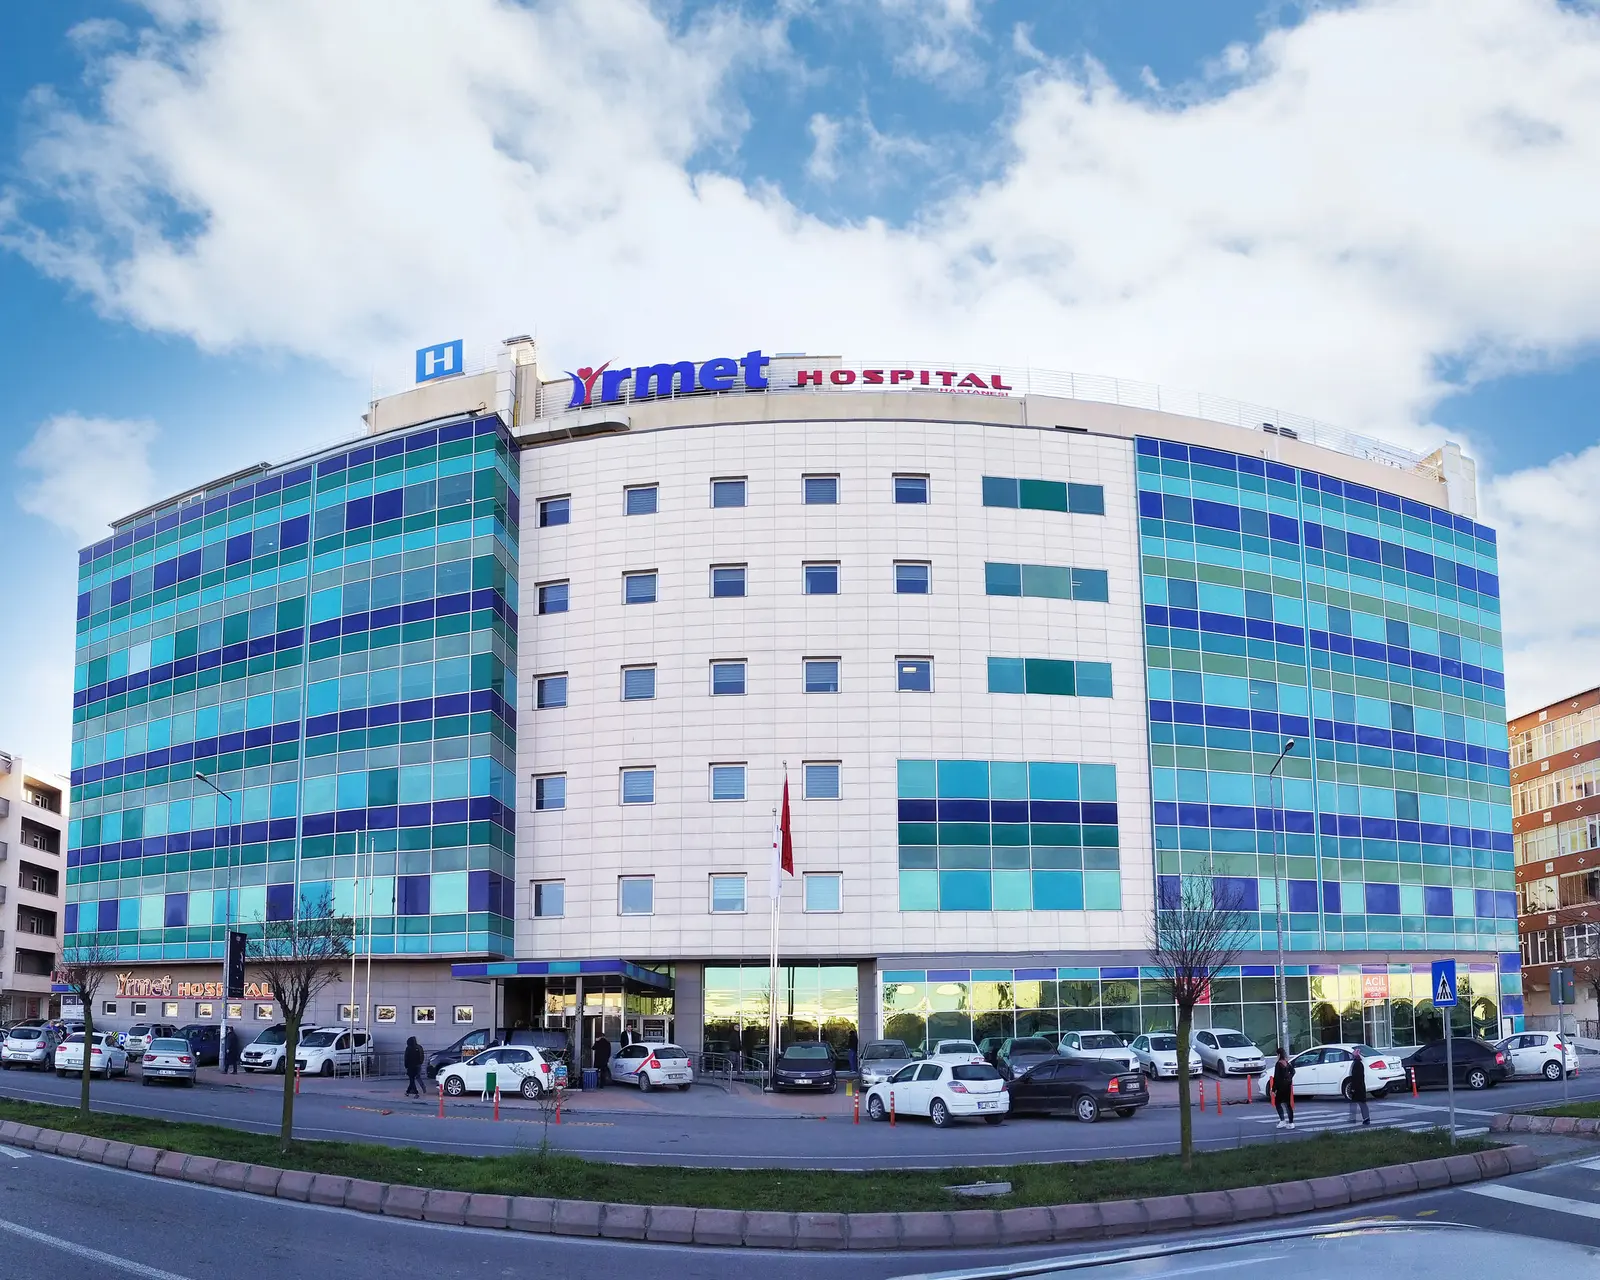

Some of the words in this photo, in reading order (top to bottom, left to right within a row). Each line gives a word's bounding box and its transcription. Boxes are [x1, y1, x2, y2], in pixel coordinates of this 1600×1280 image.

[425, 345, 454, 376] H
[797, 369, 1013, 390] HOSPITAL
[177, 982, 274, 997] HOSPAL
[119, 1035, 126, 1045] P
